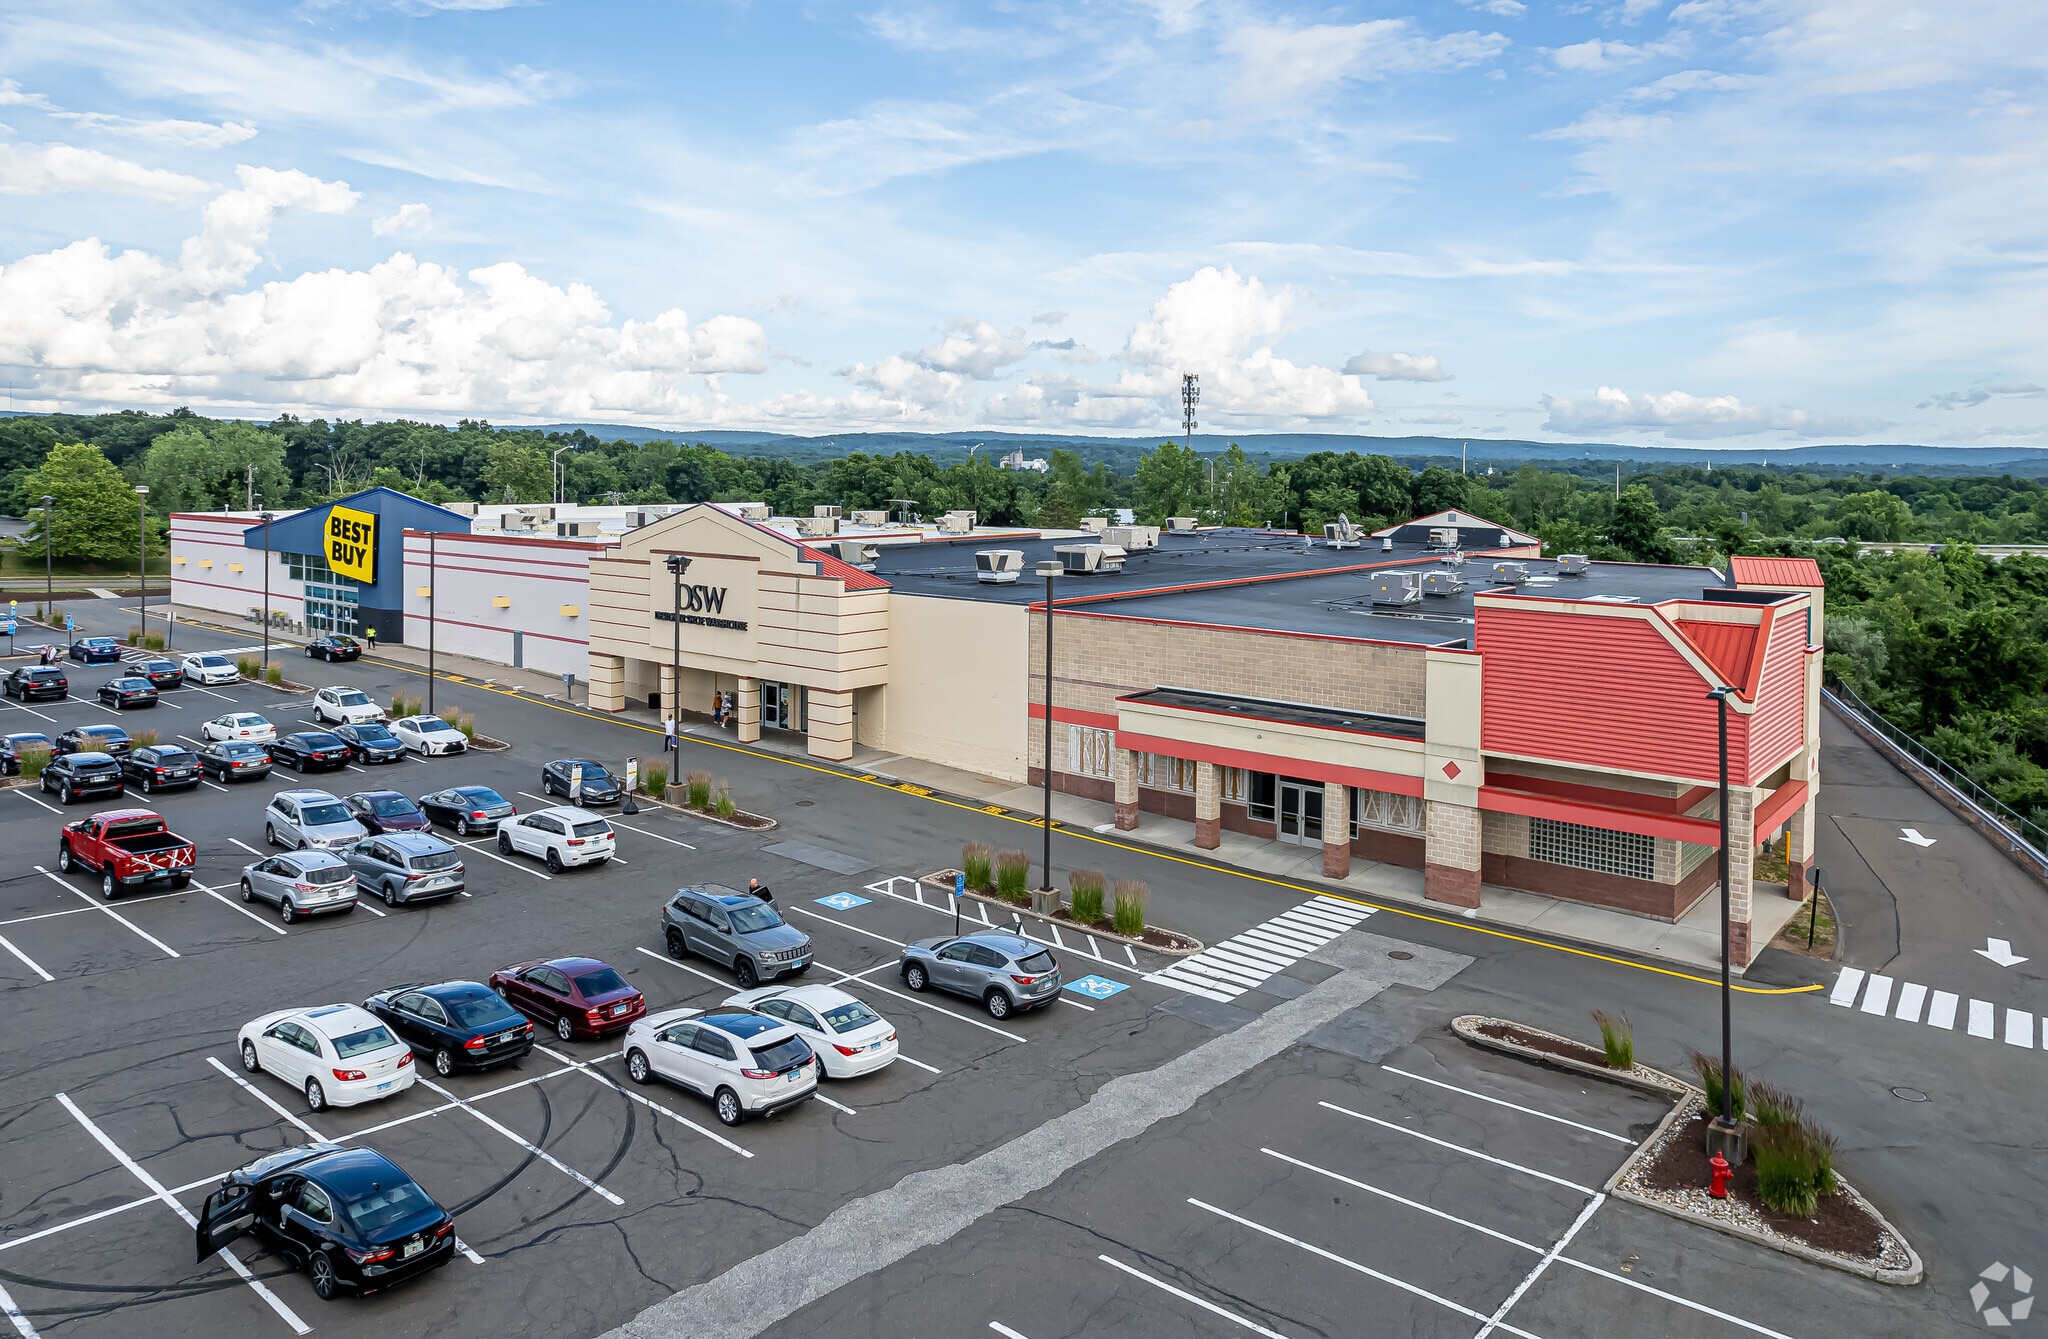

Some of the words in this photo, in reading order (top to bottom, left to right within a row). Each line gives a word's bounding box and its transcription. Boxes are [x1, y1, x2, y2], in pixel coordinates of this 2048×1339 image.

[331, 516, 371, 546] BEST
[332, 540, 367, 569] BUY
[674, 583, 728, 614] DSW
[705, 616, 748, 631] WAREHOUSE
